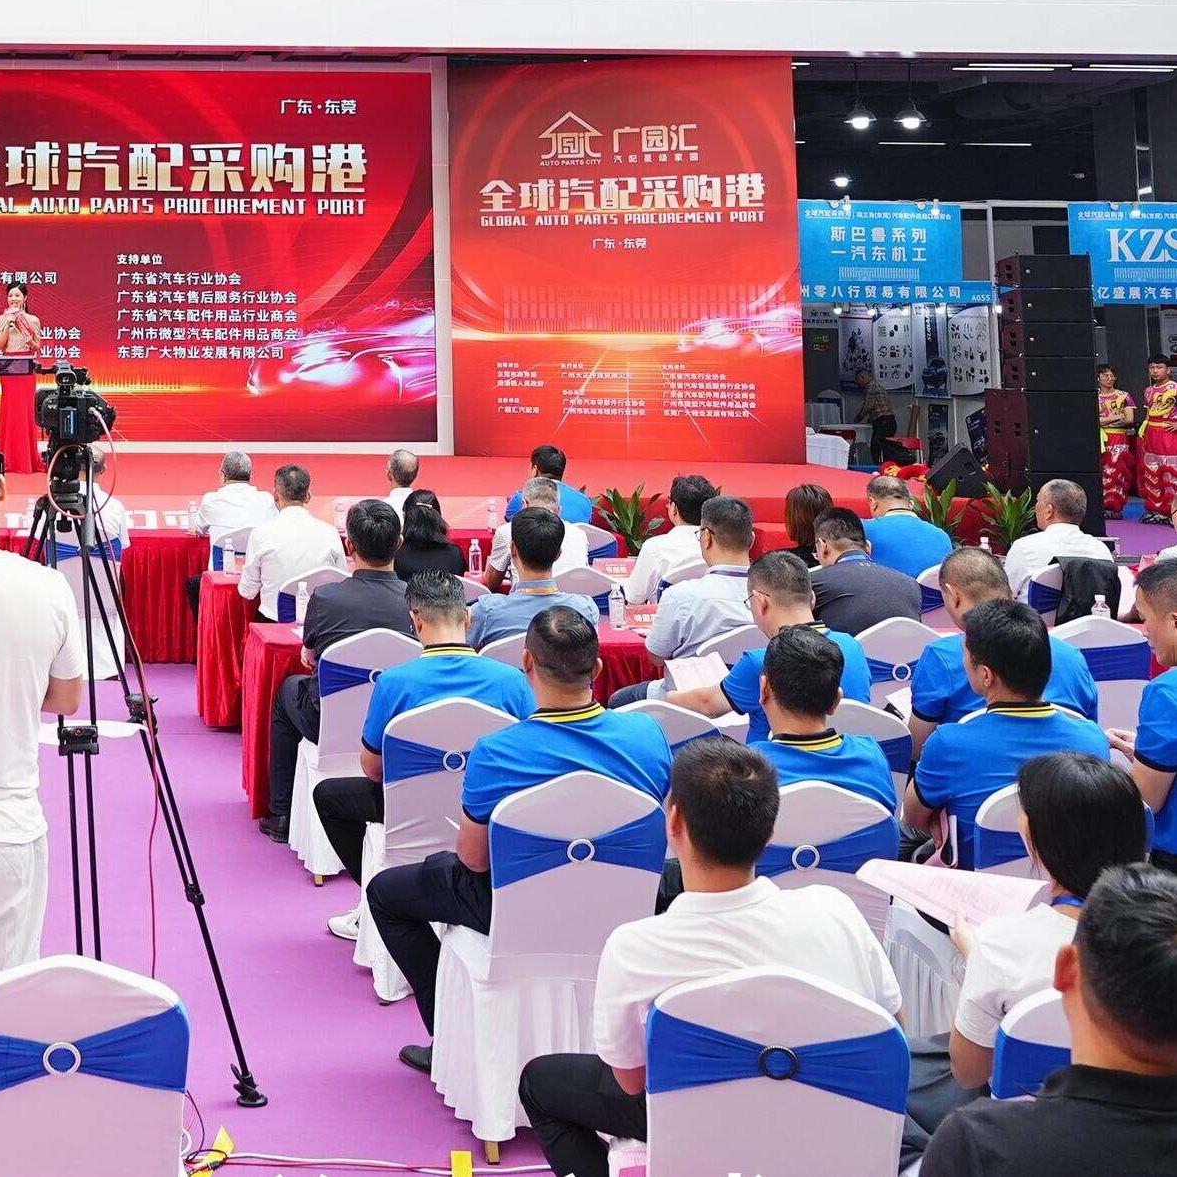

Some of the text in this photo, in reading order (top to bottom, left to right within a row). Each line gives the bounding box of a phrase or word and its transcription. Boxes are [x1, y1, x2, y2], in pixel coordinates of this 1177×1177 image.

[613, 124, 699, 152] 广园汇
[479, 172, 765, 212] 全球汽配采购港
[30, 196, 80, 213] AUTO
[90, 197, 154, 214] PARTS
[164, 197, 306, 215] PROCUREMENT
[317, 198, 365, 215] PORT
[481, 211, 765, 227] GLOBAL AUTO PARTS PROCUREMENT PORT
[830, 226, 927, 243] 斯巴鲁系列
[117, 254, 163, 265] 支持单位
[831, 246, 927, 262] 一汽东机工
[116, 272, 242, 286] 广东省汽车行业协会
[116, 291, 297, 304] 广东省汽车售后服务行业协会
[116, 309, 297, 322] 广东省汽车配件用品行业商会
[116, 328, 298, 341] 广州市微型汽车配件用品商会
[117, 346, 284, 360] 东莞广大物业发展有限公司
